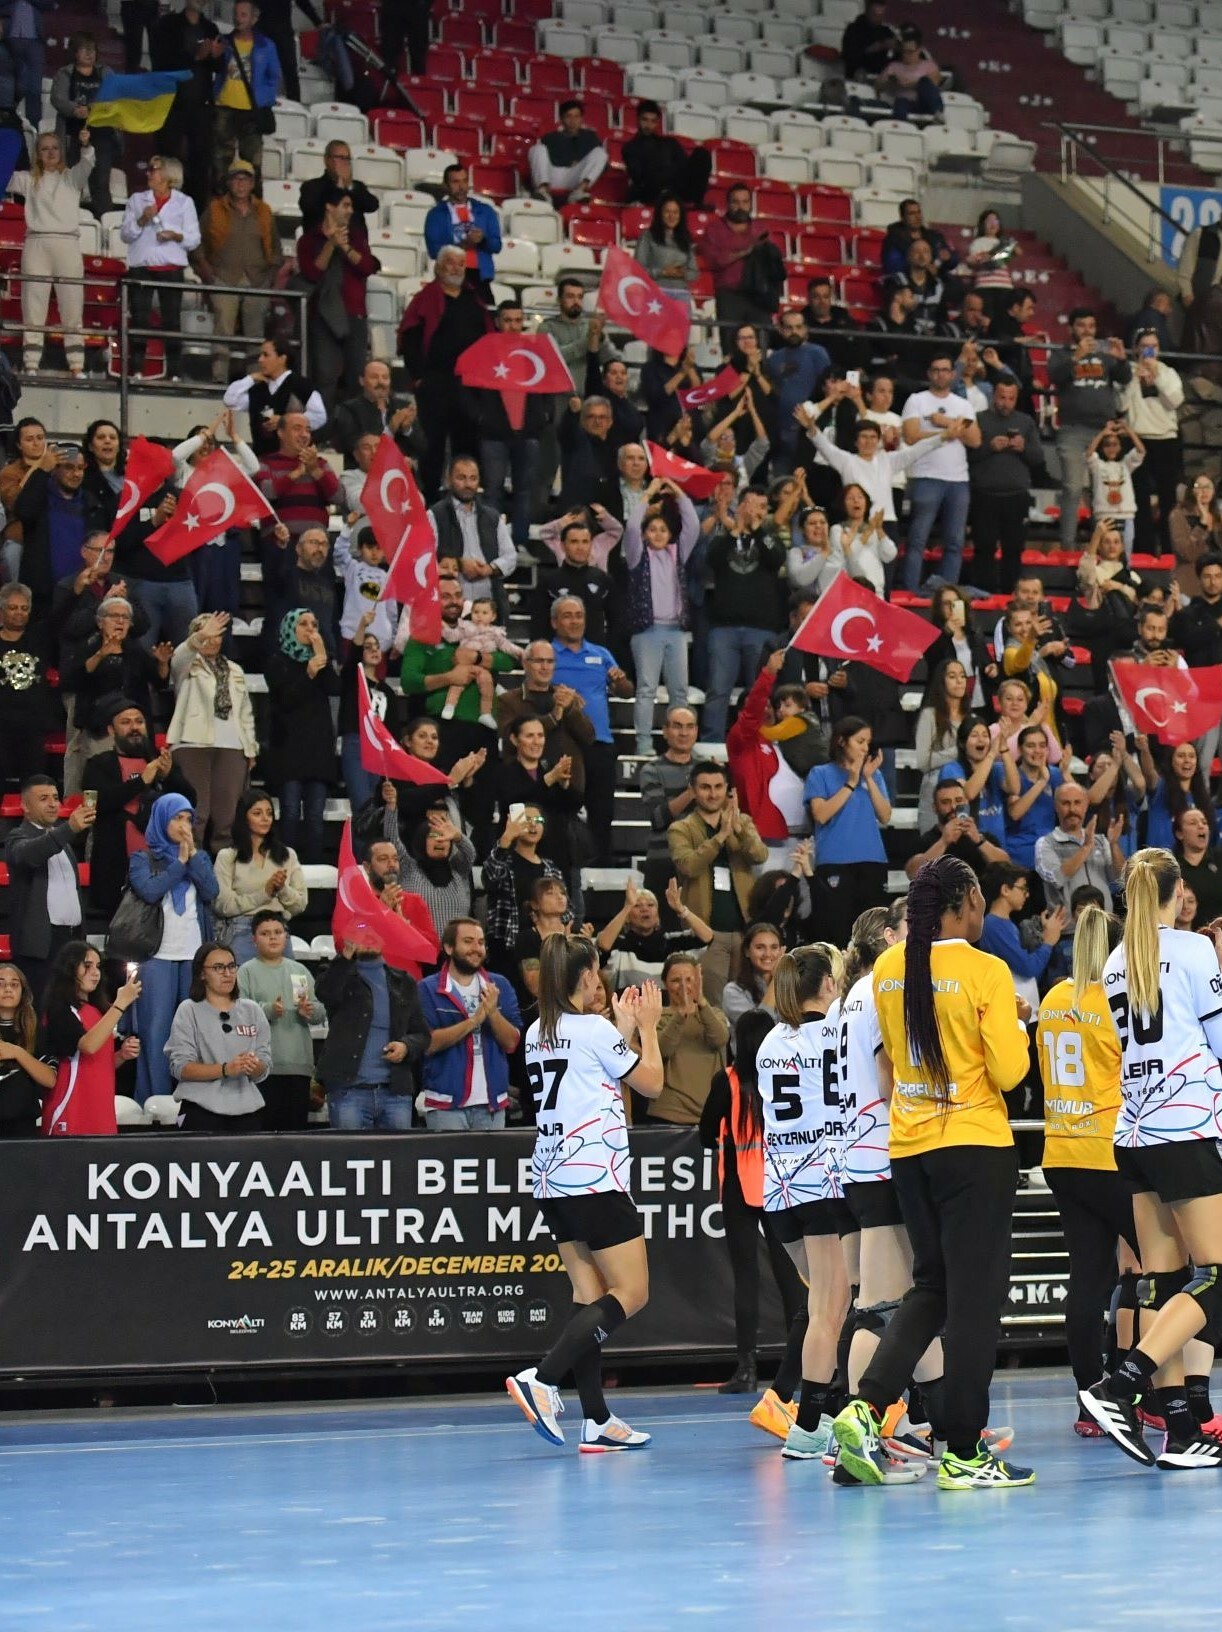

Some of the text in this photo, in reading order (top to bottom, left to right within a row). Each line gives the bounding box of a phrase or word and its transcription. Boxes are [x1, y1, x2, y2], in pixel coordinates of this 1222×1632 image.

[1042, 1008, 1101, 1026] ONYAALTI
[1043, 1031, 1085, 1087] 18
[525, 1058, 568, 1113] 27
[771, 1074, 803, 1122] 5
[88, 1148, 712, 1200] KONYAALTI BELEESİ
[22, 1211, 273, 1251] ANTALYA
[297, 1206, 465, 1247] ULTRA
[228, 1259, 298, 1280] 24-25
[300, 1254, 527, 1279] ARALIK/DECEMBER
[314, 1285, 524, 1301] WWW.ANTALYAULTRA.ORG
[1026, 1283, 1050, 1305] M
[291, 1313, 305, 1321] 85
[328, 1312, 341, 1321] 57
[363, 1311, 374, 1319] 31
[397, 1310, 408, 1318] 12
[433, 1309, 440, 1317] 5
[208, 1314, 265, 1330] KONYAALTI
[290, 1322, 307, 1330] KM
[326, 1321, 343, 1329] KM
[360, 1319, 376, 1328] KM
[394, 1318, 411, 1327] KM
[428, 1317, 444, 1326] KM
